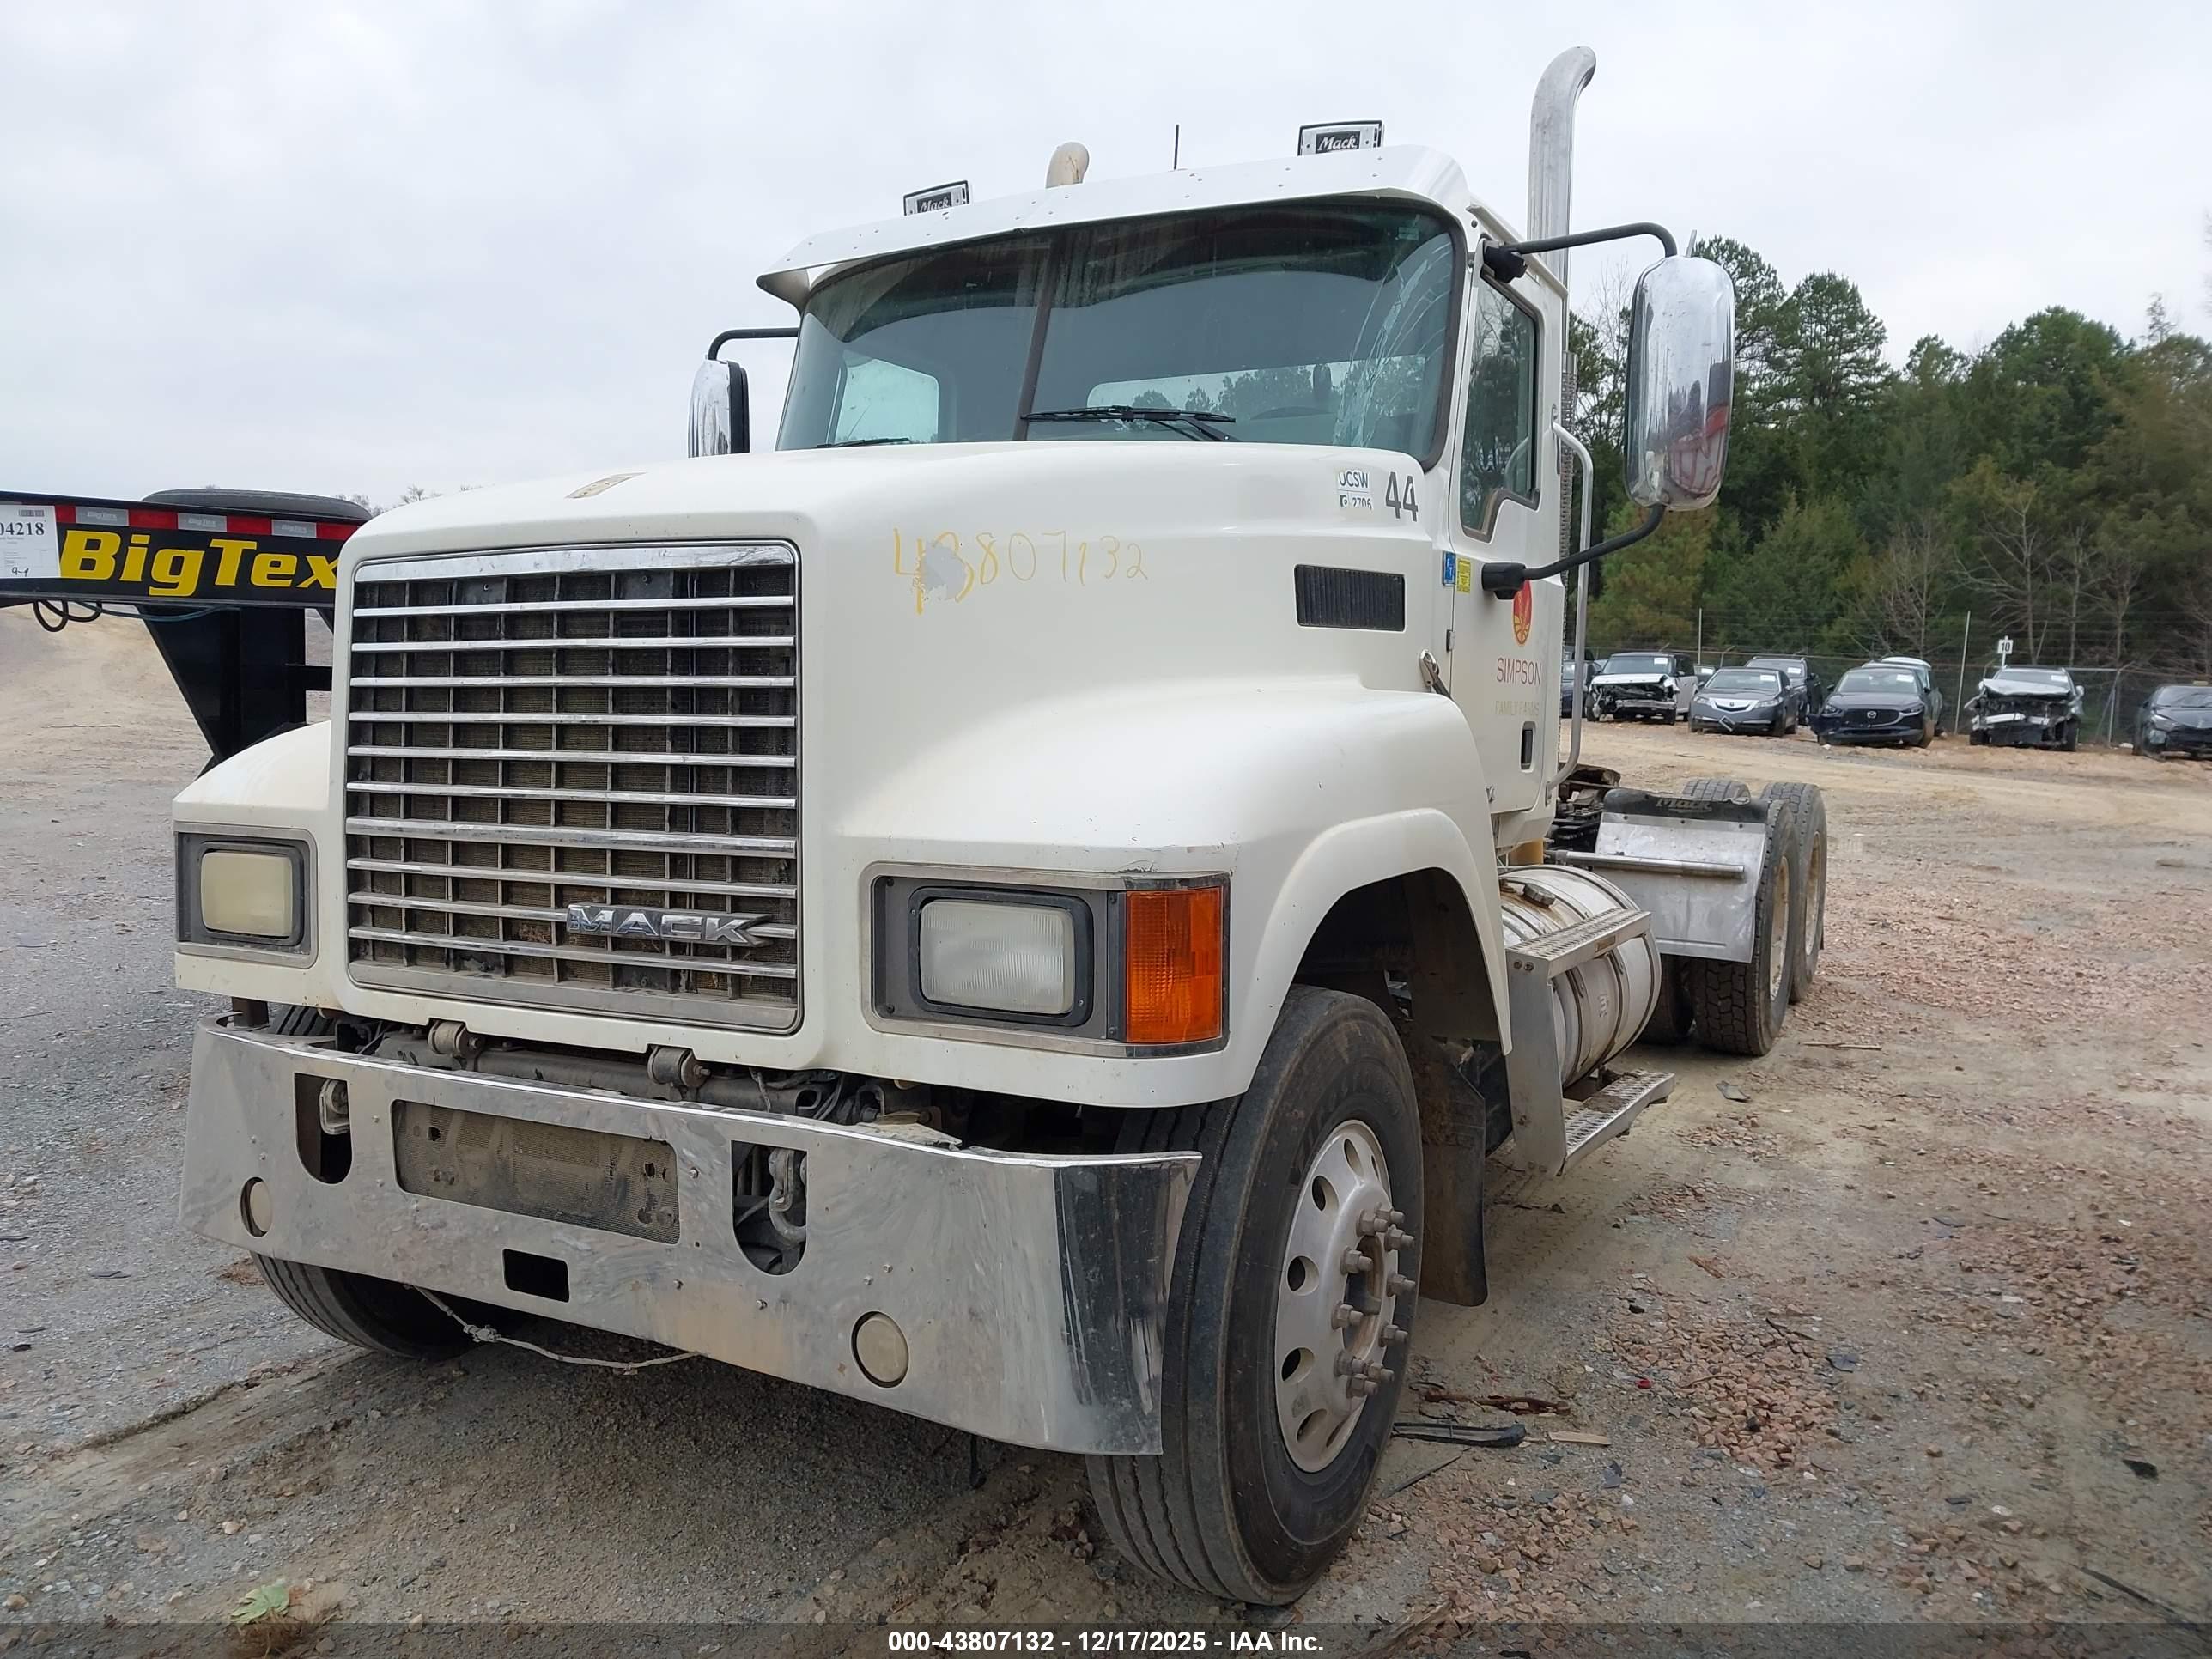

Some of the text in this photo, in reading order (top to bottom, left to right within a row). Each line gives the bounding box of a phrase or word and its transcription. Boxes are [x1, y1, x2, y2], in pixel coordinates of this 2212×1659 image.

[1317, 135, 1358, 151] Mack
[920, 196, 951, 213] Mack
[1339, 471, 1369, 489] UCSW
[1385, 471, 1419, 522] 44
[60, 529, 339, 597] BigTex
[893, 527, 1149, 616] 43807132
[2001, 641, 2011, 652] 10
[1496, 656, 1542, 686] SIMPSON
[568, 906, 754, 945] MACK
